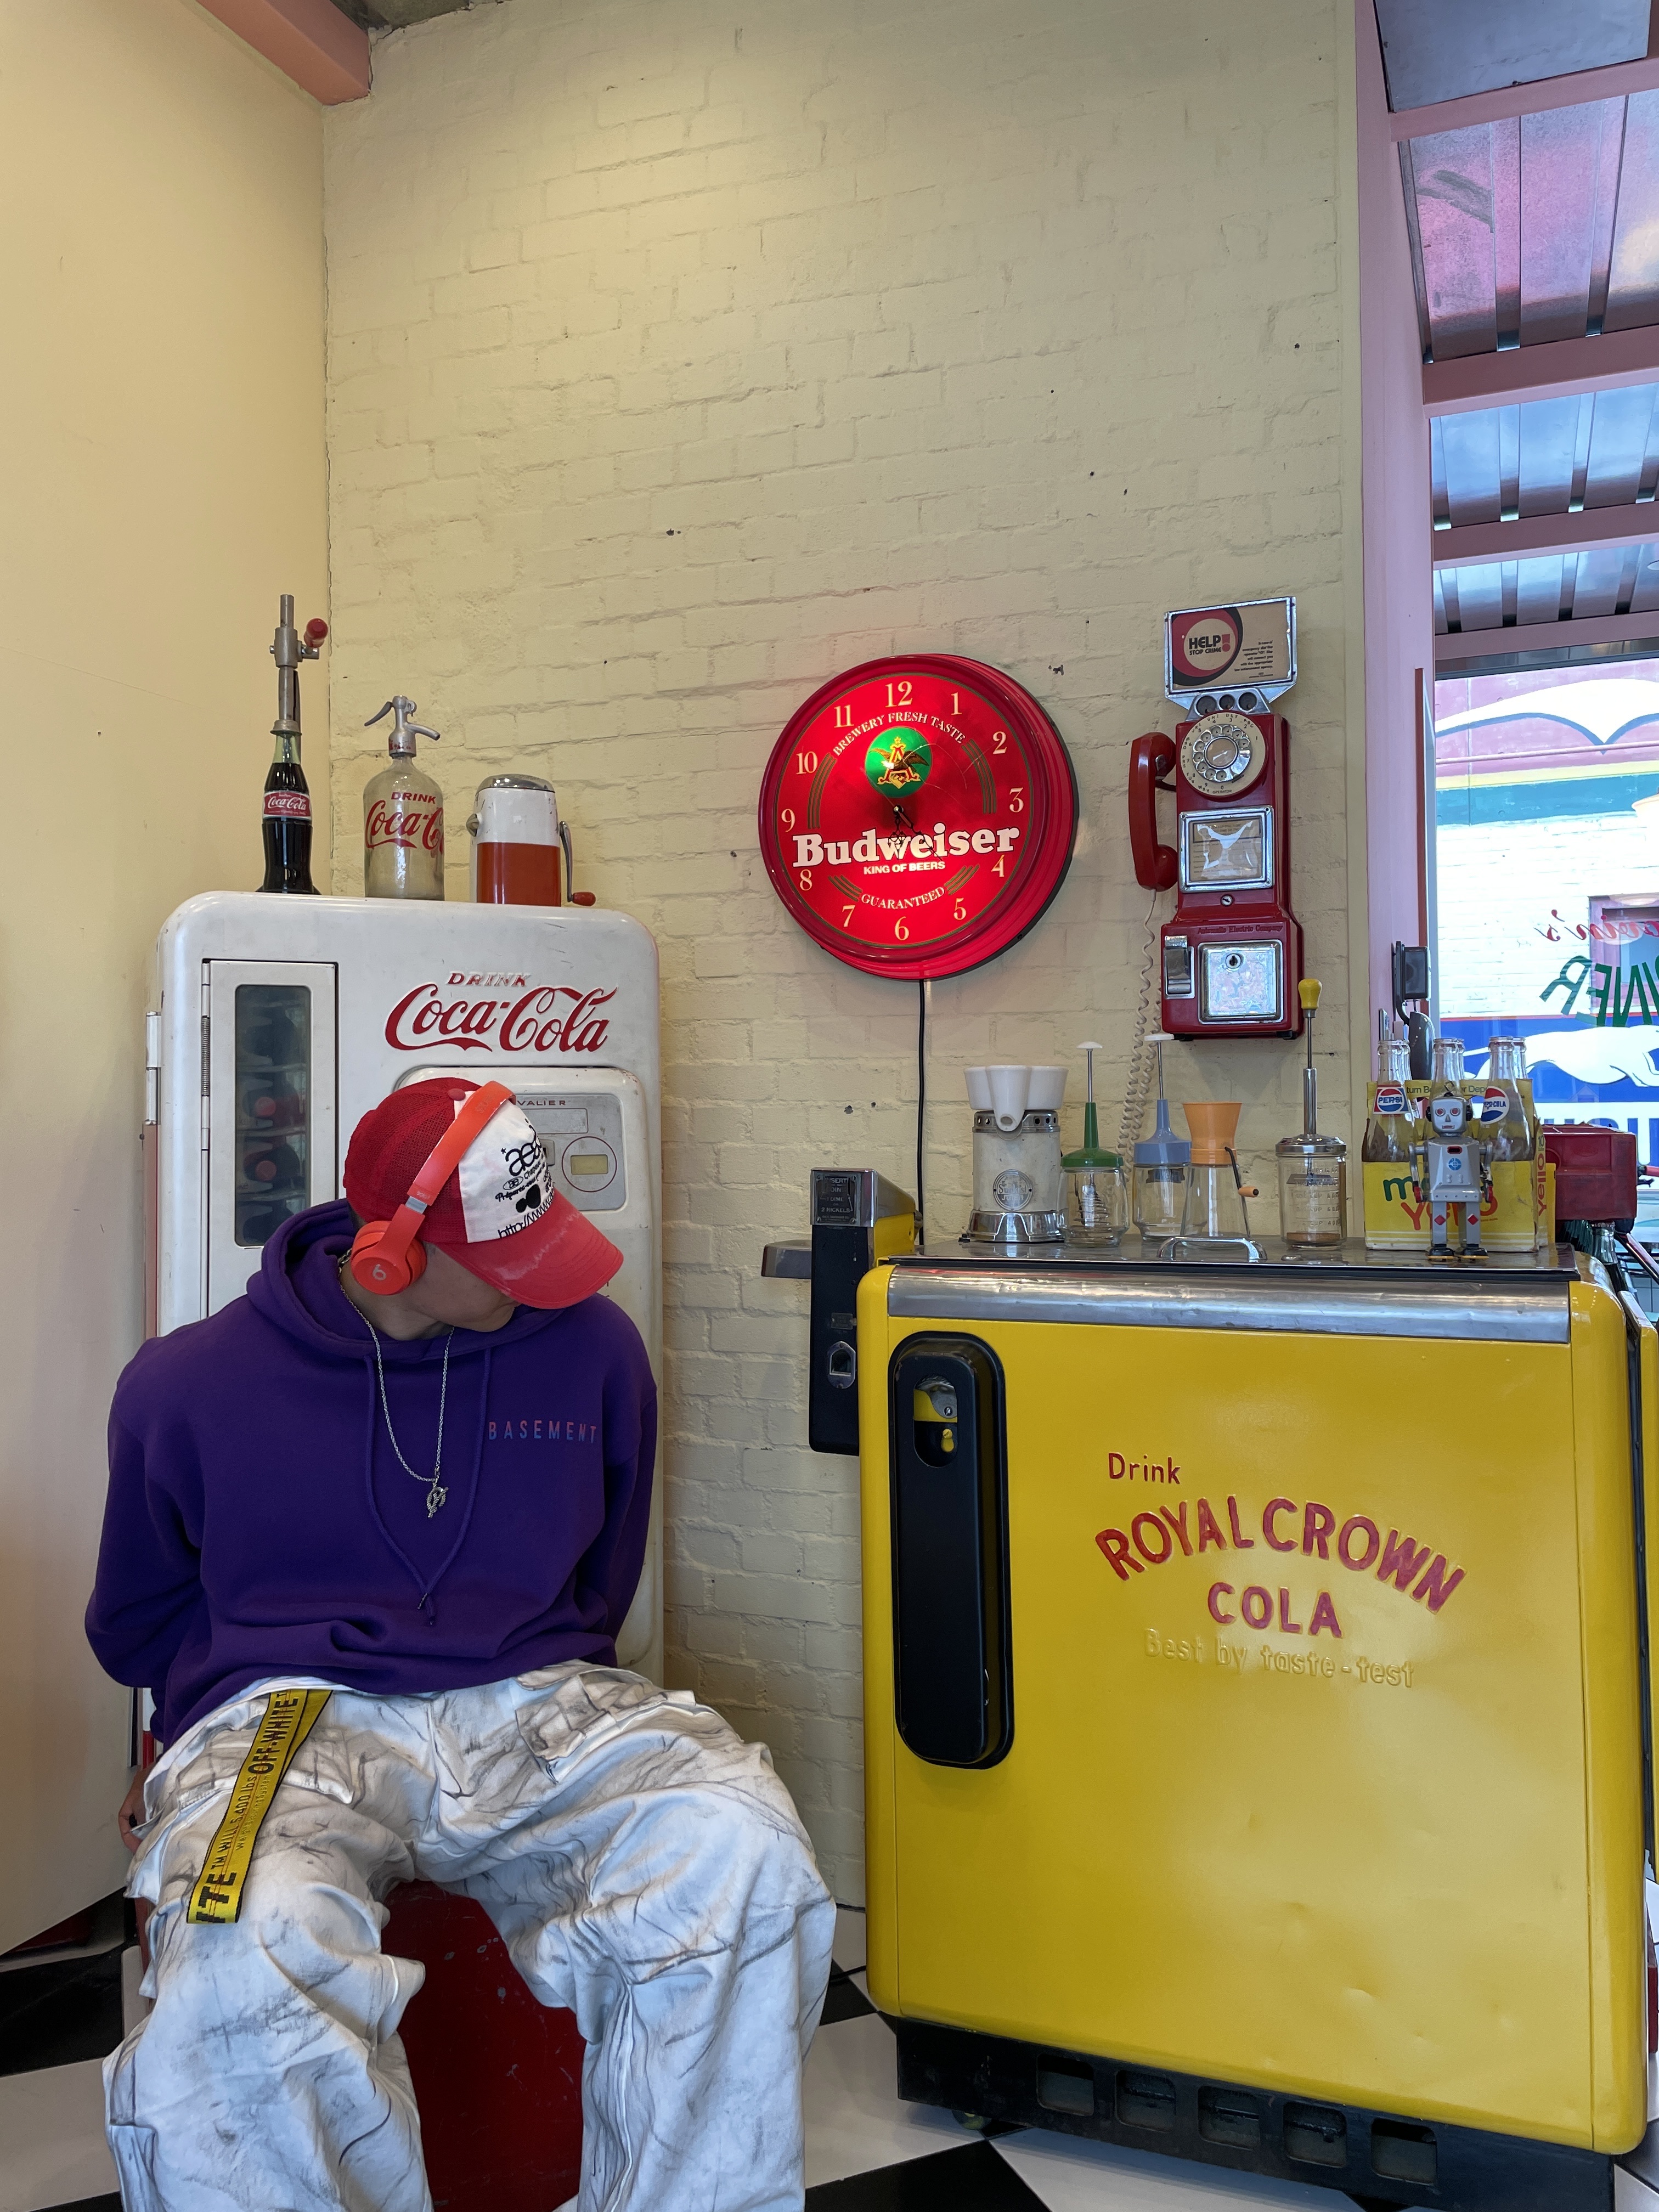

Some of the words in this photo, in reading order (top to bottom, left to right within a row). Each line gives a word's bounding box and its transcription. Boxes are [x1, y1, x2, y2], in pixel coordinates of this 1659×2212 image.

[885, 681, 913, 708] 12
[951, 692, 962, 715] 1
[834, 704, 854, 728] 11
[832, 715, 884, 757] BREWERY
[888, 712, 928, 724] FRESH
[931, 716, 966, 744] TASTE
[992, 731, 1007, 754] 2
[796, 751, 818, 774] 10
[268, 796, 307, 810] Coca-Cola
[391, 792, 437, 804] DRINK
[1009, 787, 1024, 812] 3
[781, 809, 795, 832] 9
[792, 822, 1019, 867] Budweiser
[863, 865, 890, 875] KING
[892, 864, 907, 872] OF
[909, 861, 945, 871] BEERS
[991, 855, 1005, 878] 4
[799, 869, 812, 891] 8
[861, 887, 945, 910] GUARANTEED
[953, 898, 967, 921] 5
[842, 905, 855, 927] 7
[894, 916, 910, 941] 6
[447, 972, 532, 987] DRINK
[385, 983, 618, 1052] Coca-Cola
[1537, 1153, 1547, 1217] Yello
[488, 1420, 597, 1443] BASEMENT
[1108, 1452, 1181, 1485] Drink
[1096, 1494, 1254, 1581] ROYAL
[1262, 1497, 1466, 1614] CROWN
[1207, 1582, 1343, 1638] COLA
[1144, 1628, 1203, 1663] Best
[1216, 1635, 1247, 1674] by
[247, 1697, 298, 1775] OFF-WHITE
[241, 1776, 257, 1793] lbs
[217, 1827, 238, 1853] WILL
